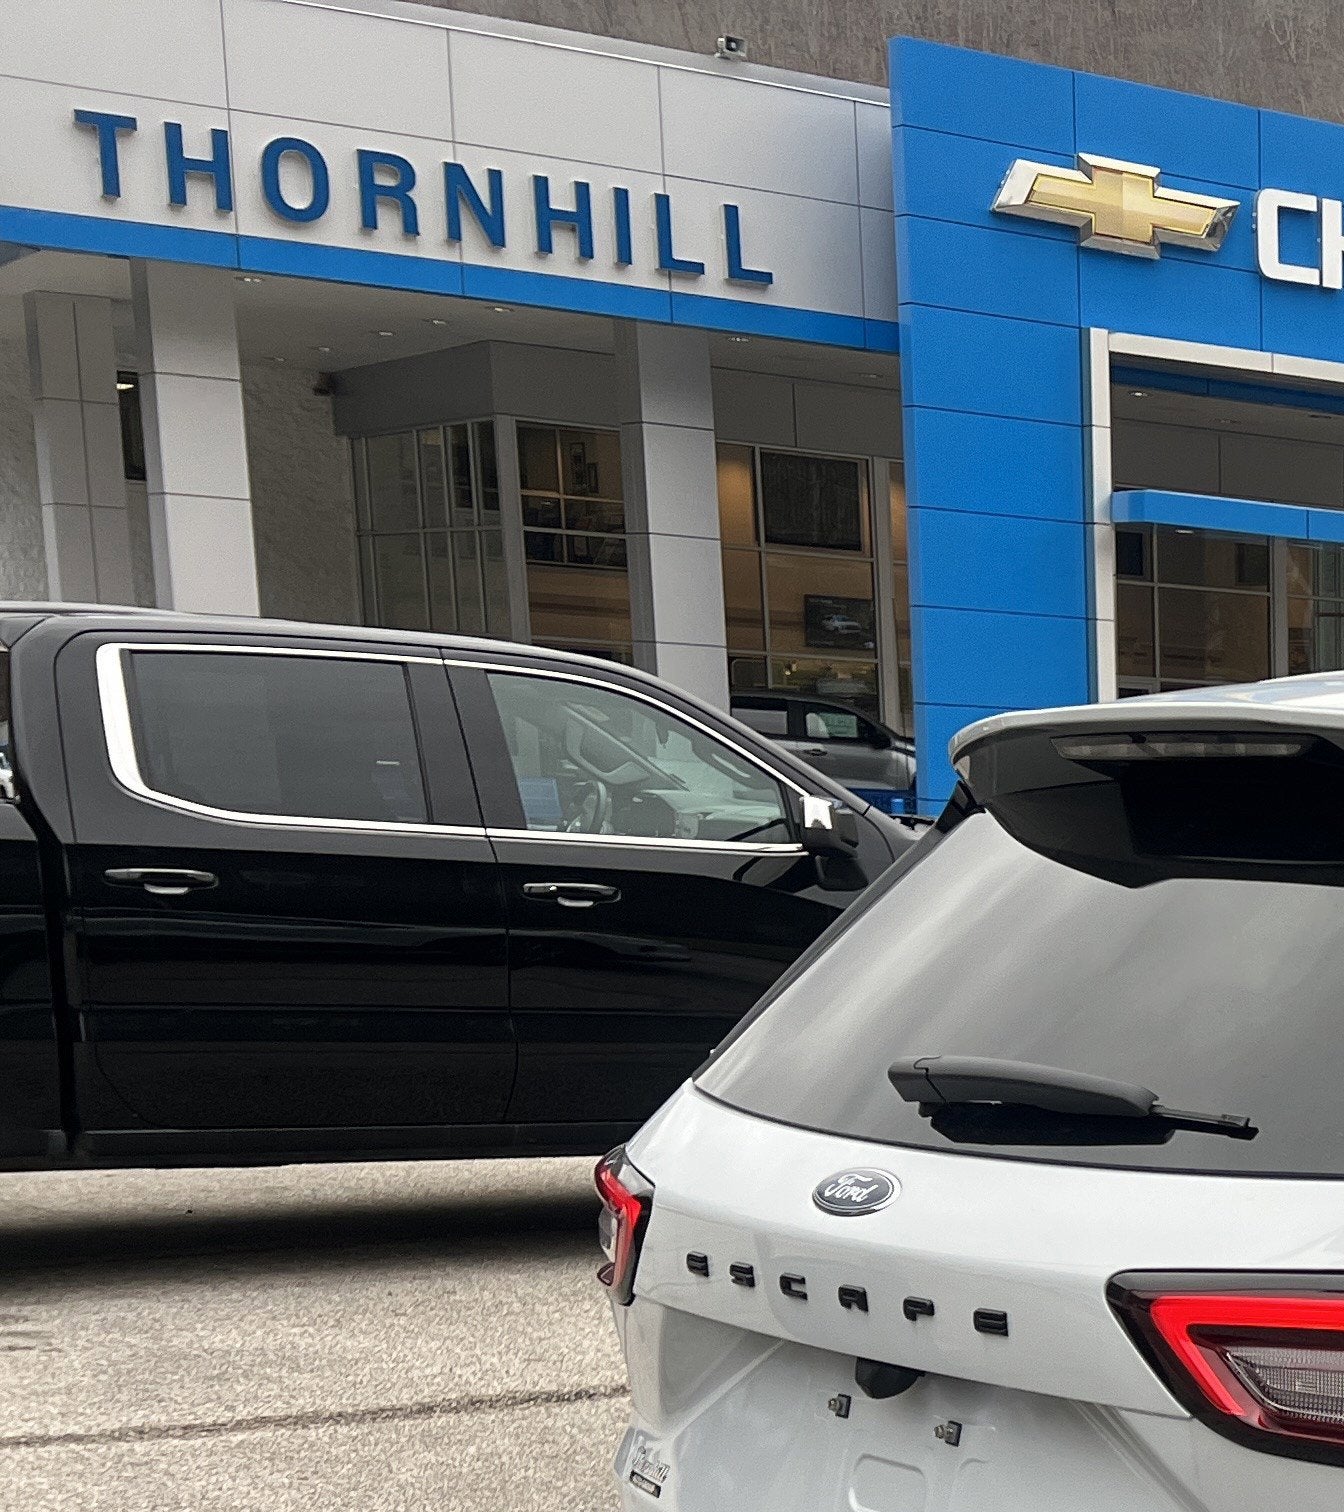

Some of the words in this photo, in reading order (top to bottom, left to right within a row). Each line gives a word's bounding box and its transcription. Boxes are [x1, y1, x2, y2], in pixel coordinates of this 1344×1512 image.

[73, 108, 774, 286] THORNHILL
[824, 1173, 879, 1203] Ford
[686, 1250, 1009, 1337] ESCAPE
